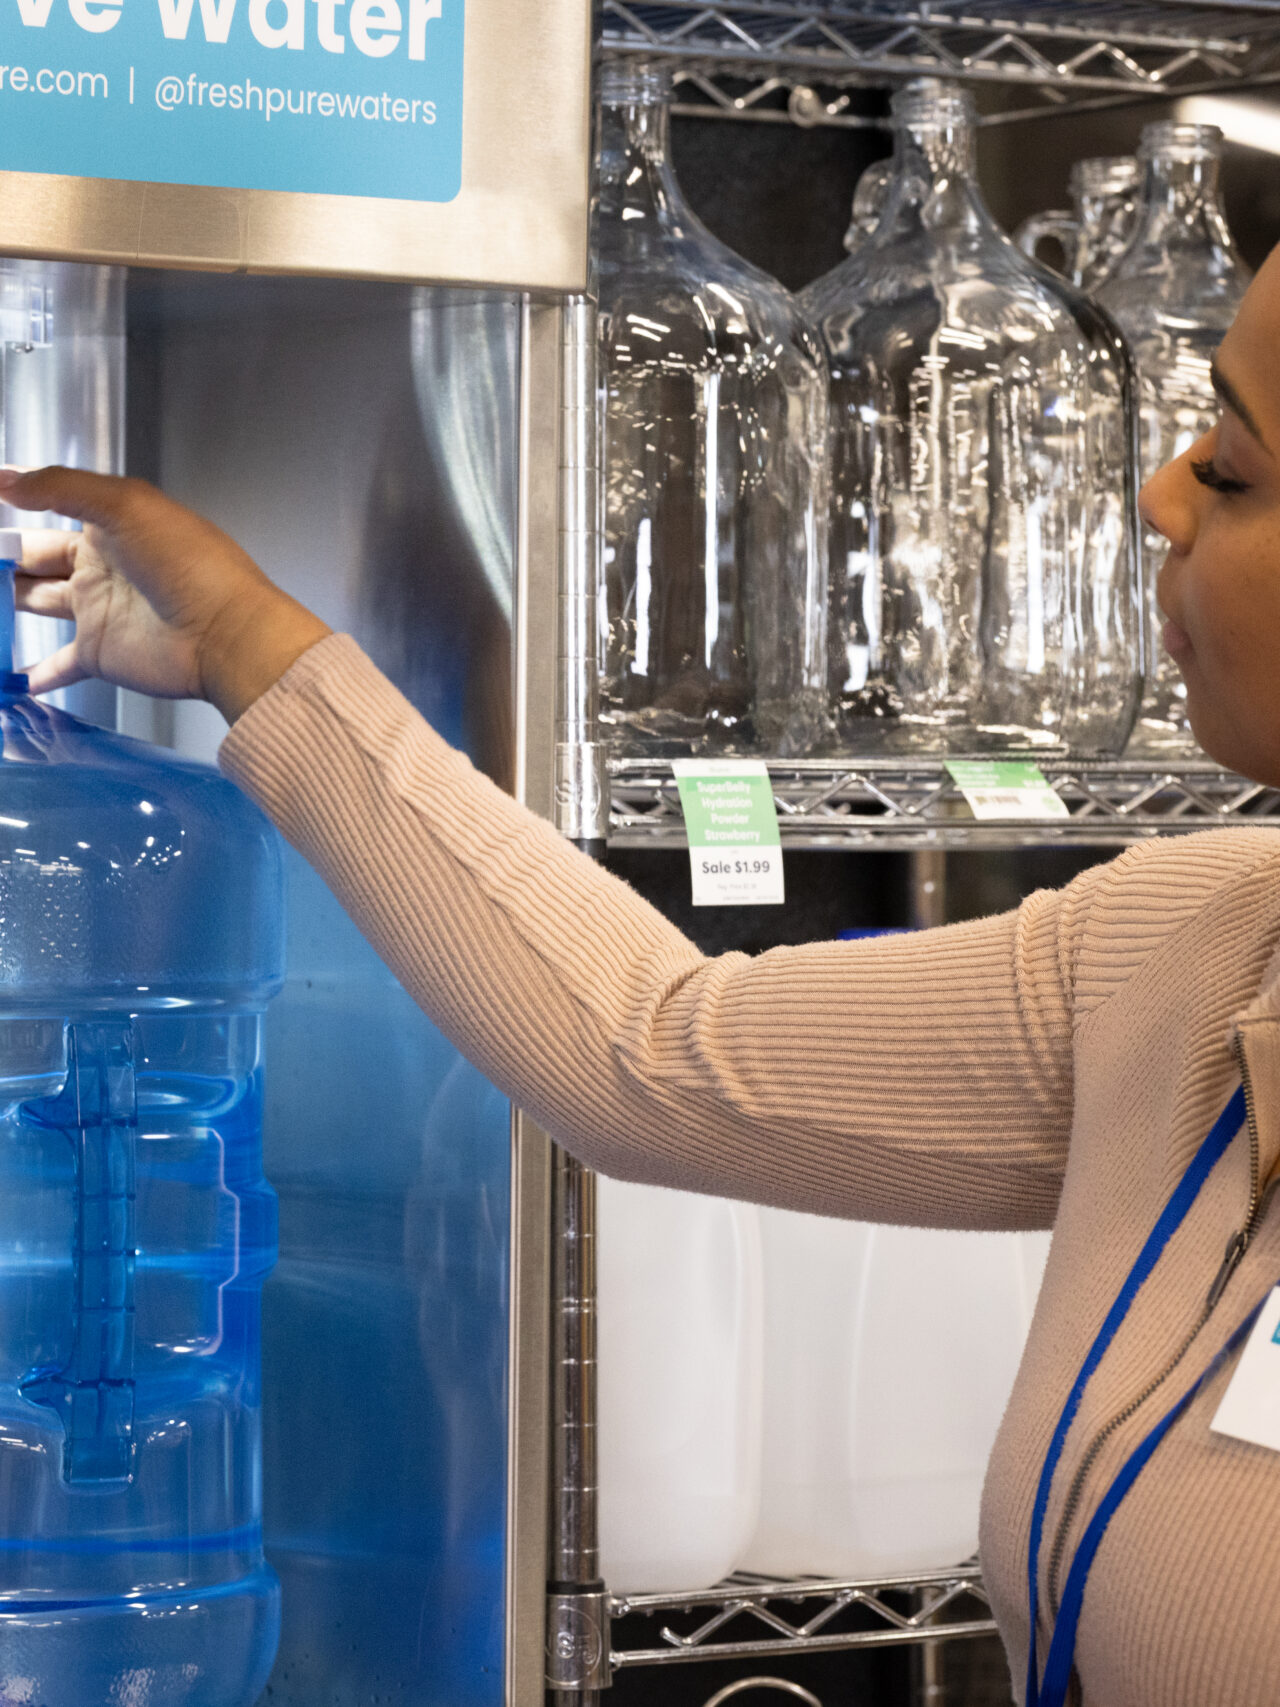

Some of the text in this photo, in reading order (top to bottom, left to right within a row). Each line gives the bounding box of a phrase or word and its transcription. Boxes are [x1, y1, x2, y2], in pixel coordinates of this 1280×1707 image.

[155, 73, 437, 124] @freshpurewaters
[701, 797, 753, 811] Hydration
[710, 813, 749, 825] Powder
[704, 829, 760, 843] Strawberry
[702, 860, 770, 874] Sale $1.99
